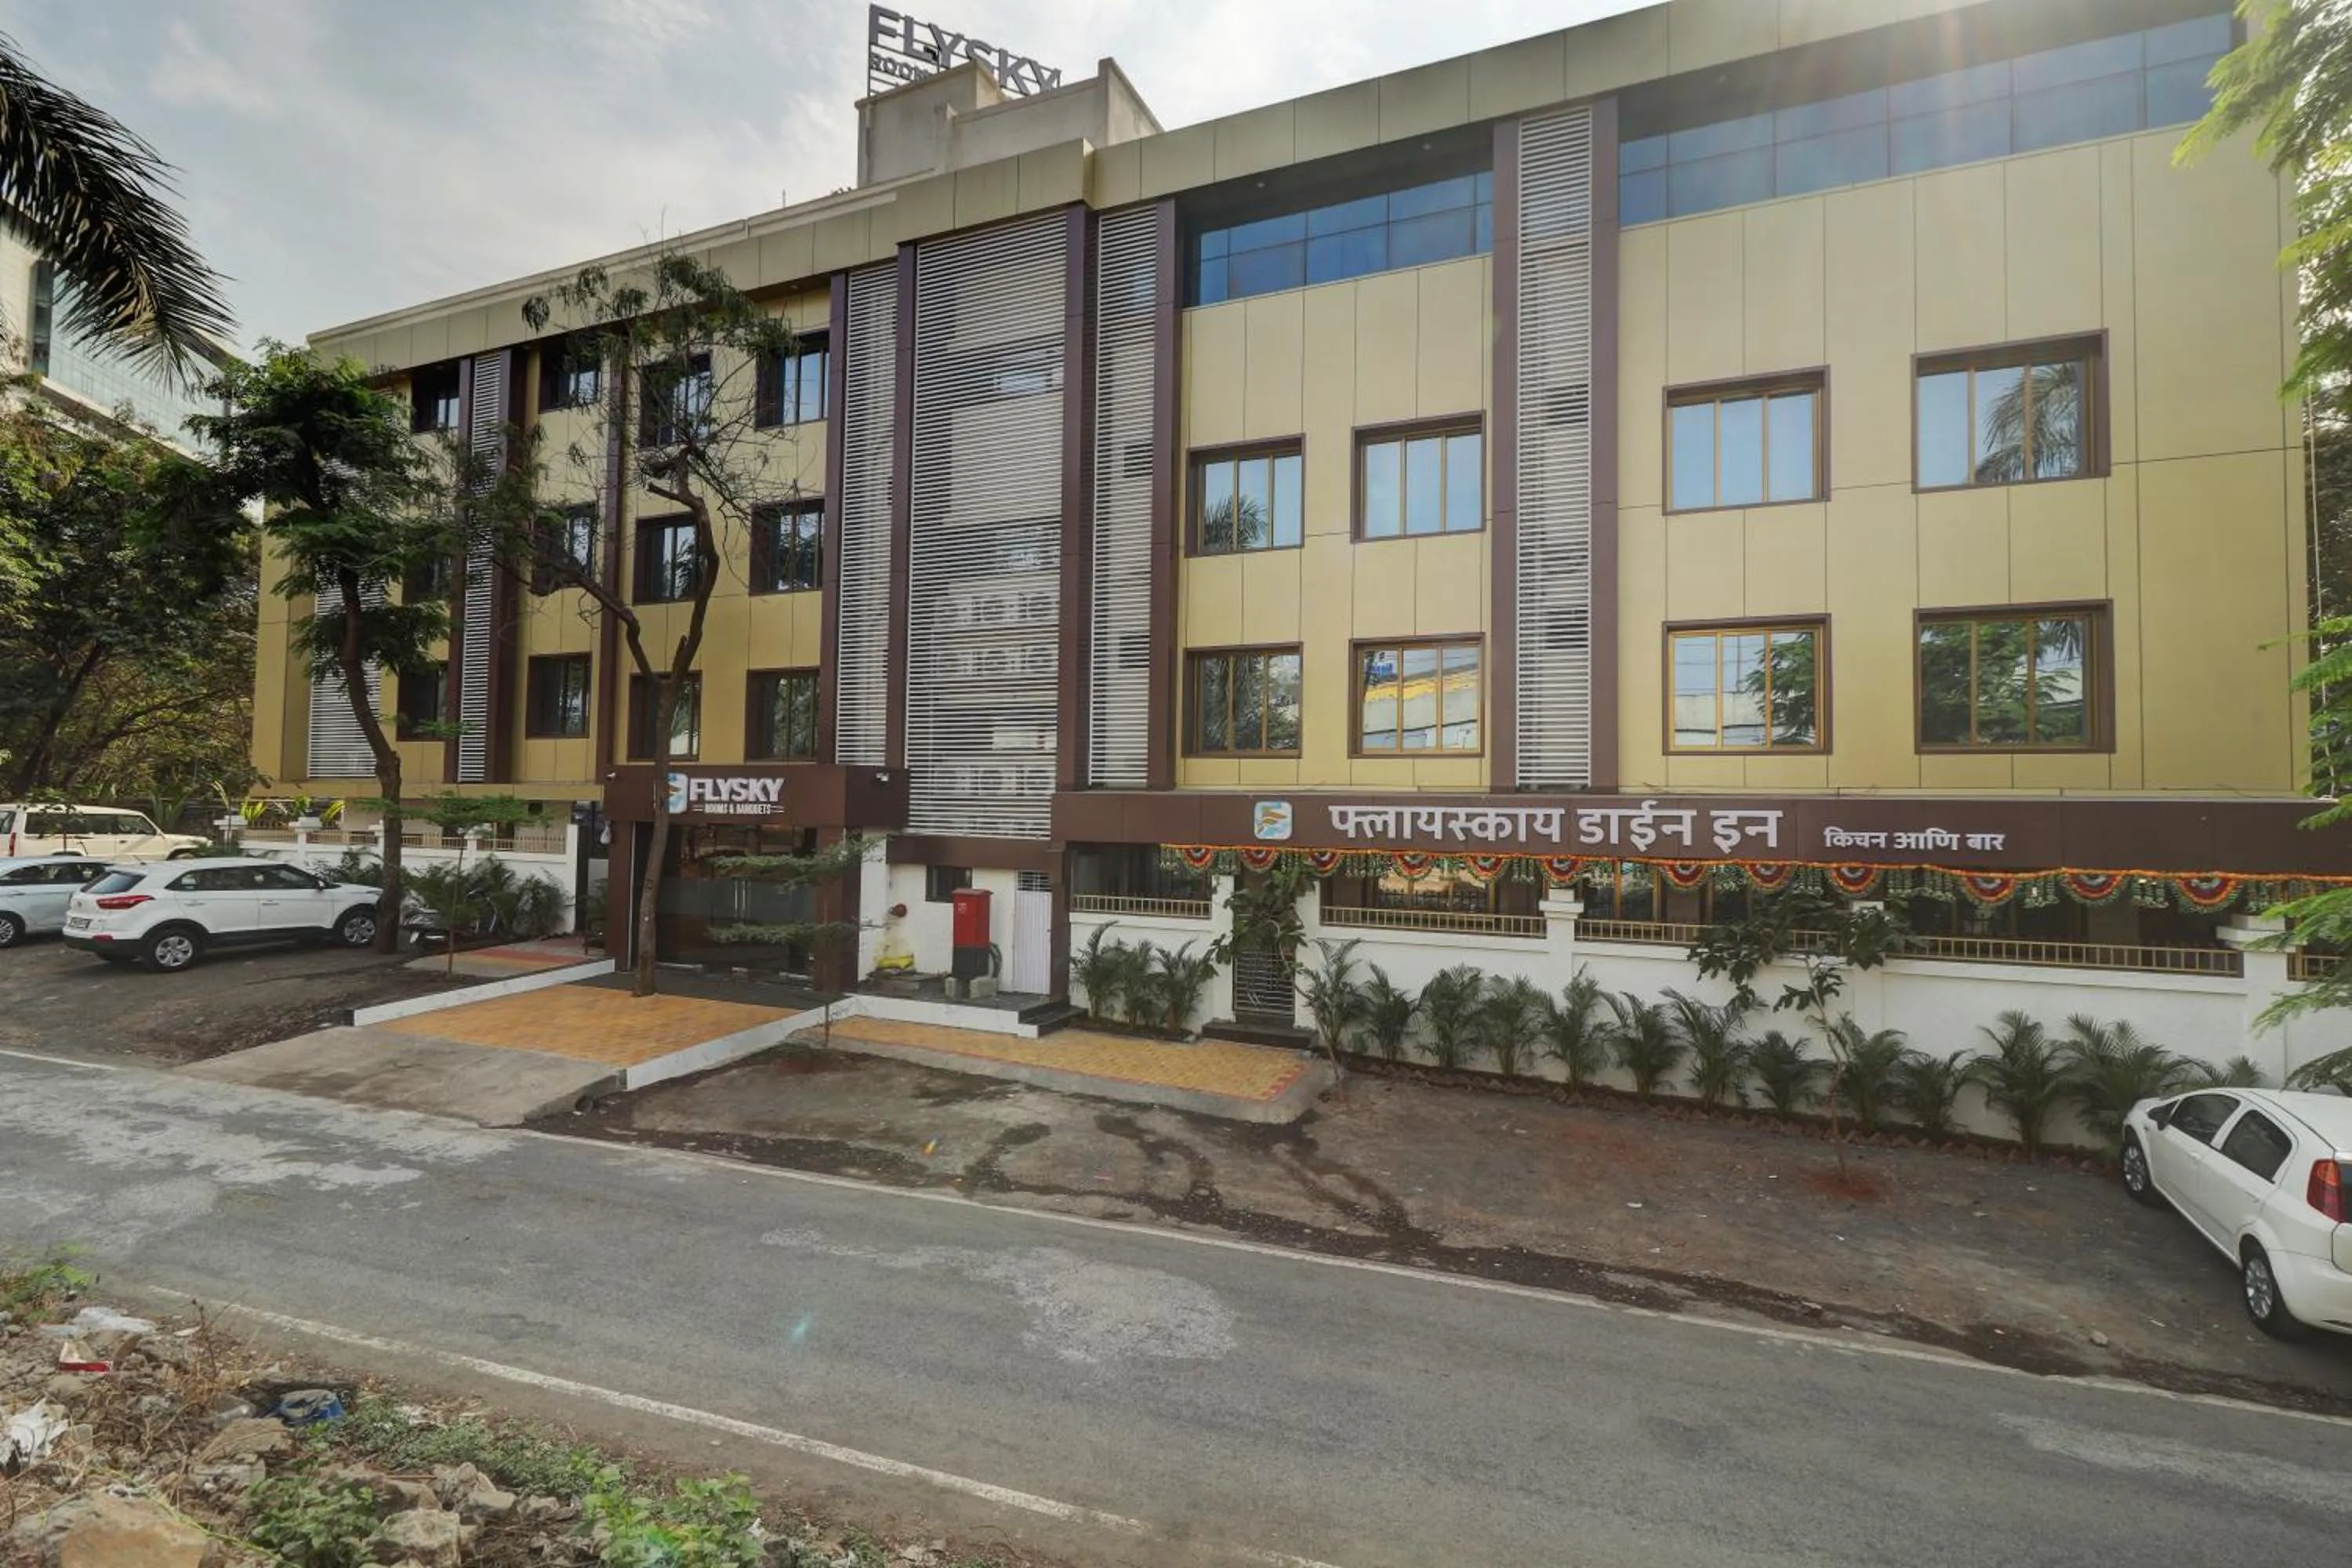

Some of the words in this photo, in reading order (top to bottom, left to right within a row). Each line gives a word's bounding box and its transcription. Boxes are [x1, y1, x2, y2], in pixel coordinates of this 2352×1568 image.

[690, 777, 784, 801] FLYSKY
[1328, 805, 1566, 842] फ्लायस्काय
[1577, 799, 1697, 852] डाईन
[1710, 810, 1784, 854] इन
[1823, 826, 1888, 848] किचन
[1893, 827, 1960, 851] आणि
[1965, 833, 2006, 851] बार
